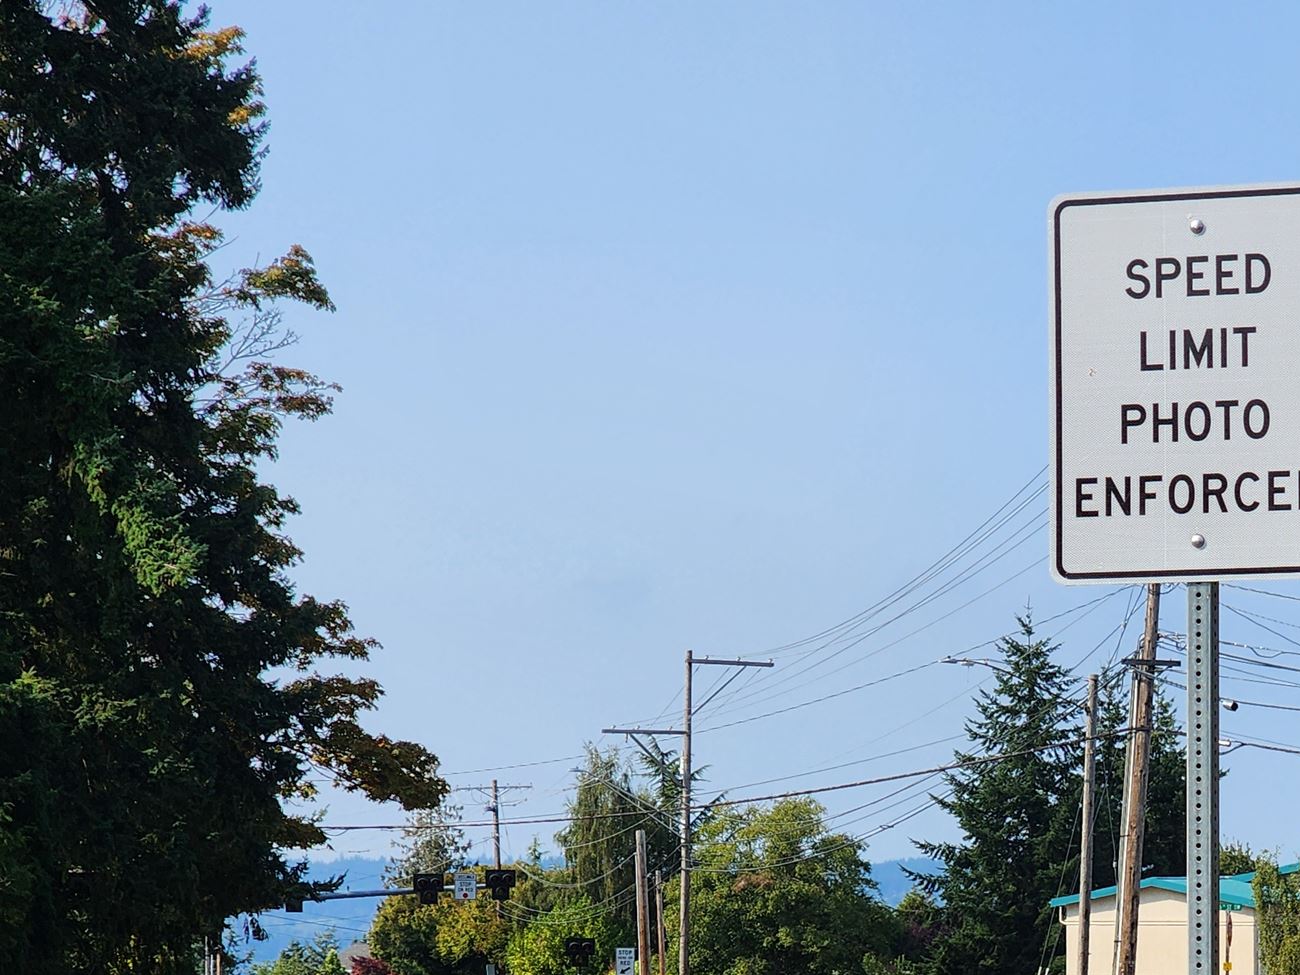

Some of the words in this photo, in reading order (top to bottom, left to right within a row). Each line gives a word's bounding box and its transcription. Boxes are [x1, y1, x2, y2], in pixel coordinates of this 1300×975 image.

[1125, 253, 1271, 299] SPEED
[1140, 327, 1257, 371] LIMIT
[1121, 399, 1270, 444] PHOTO
